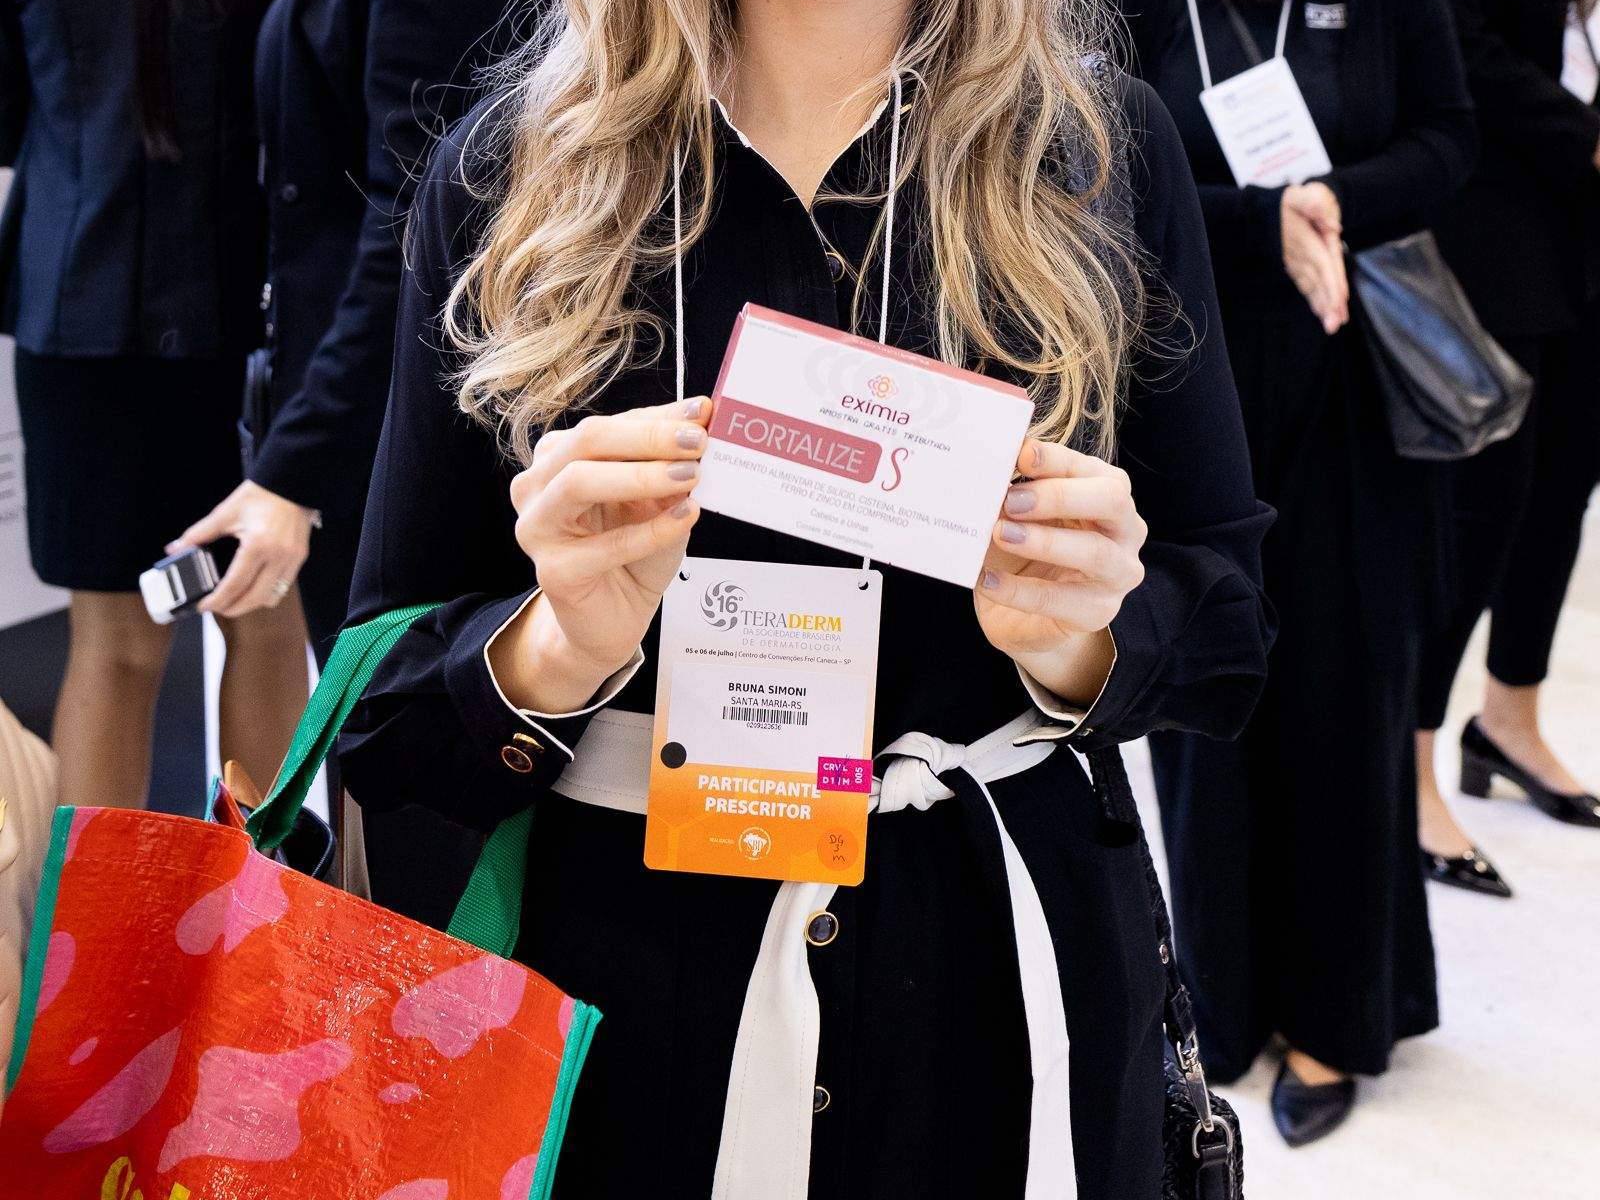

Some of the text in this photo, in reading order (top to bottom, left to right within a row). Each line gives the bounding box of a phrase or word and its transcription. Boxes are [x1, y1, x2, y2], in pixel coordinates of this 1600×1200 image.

[819, 407, 951, 452] AMOSTRA GRATIS TRIBUTADA
[727, 411, 866, 474] FORTALIZE
[713, 451, 768, 474] SUPLEMENTO
[768, 468, 813, 487] ALIMENTAR
[814, 482, 827, 494] DE
[934, 517, 969, 535] VITAMINA
[781, 482, 808, 497] FERRO
[816, 493, 842, 508] ZINCO
[842, 500, 856, 511] EM
[857, 504, 910, 528] COMPRIMIDO
[741, 610, 842, 632] TERADERM
[742, 638, 841, 652] DE DERMATOLOGIA
[743, 627, 841, 642] DA SOCIEDADE BRASILEIRA
[738, 651, 757, 659] Centro
[768, 654, 803, 664] Convenções
[816, 657, 838, 665] Caneca
[728, 682, 807, 696] BRUNA SIMONI
[731, 697, 802, 710] SANTA MARIA-RS
[697, 774, 822, 799] PARTICIPANTE
[704, 797, 812, 820] PRESCRITOR
